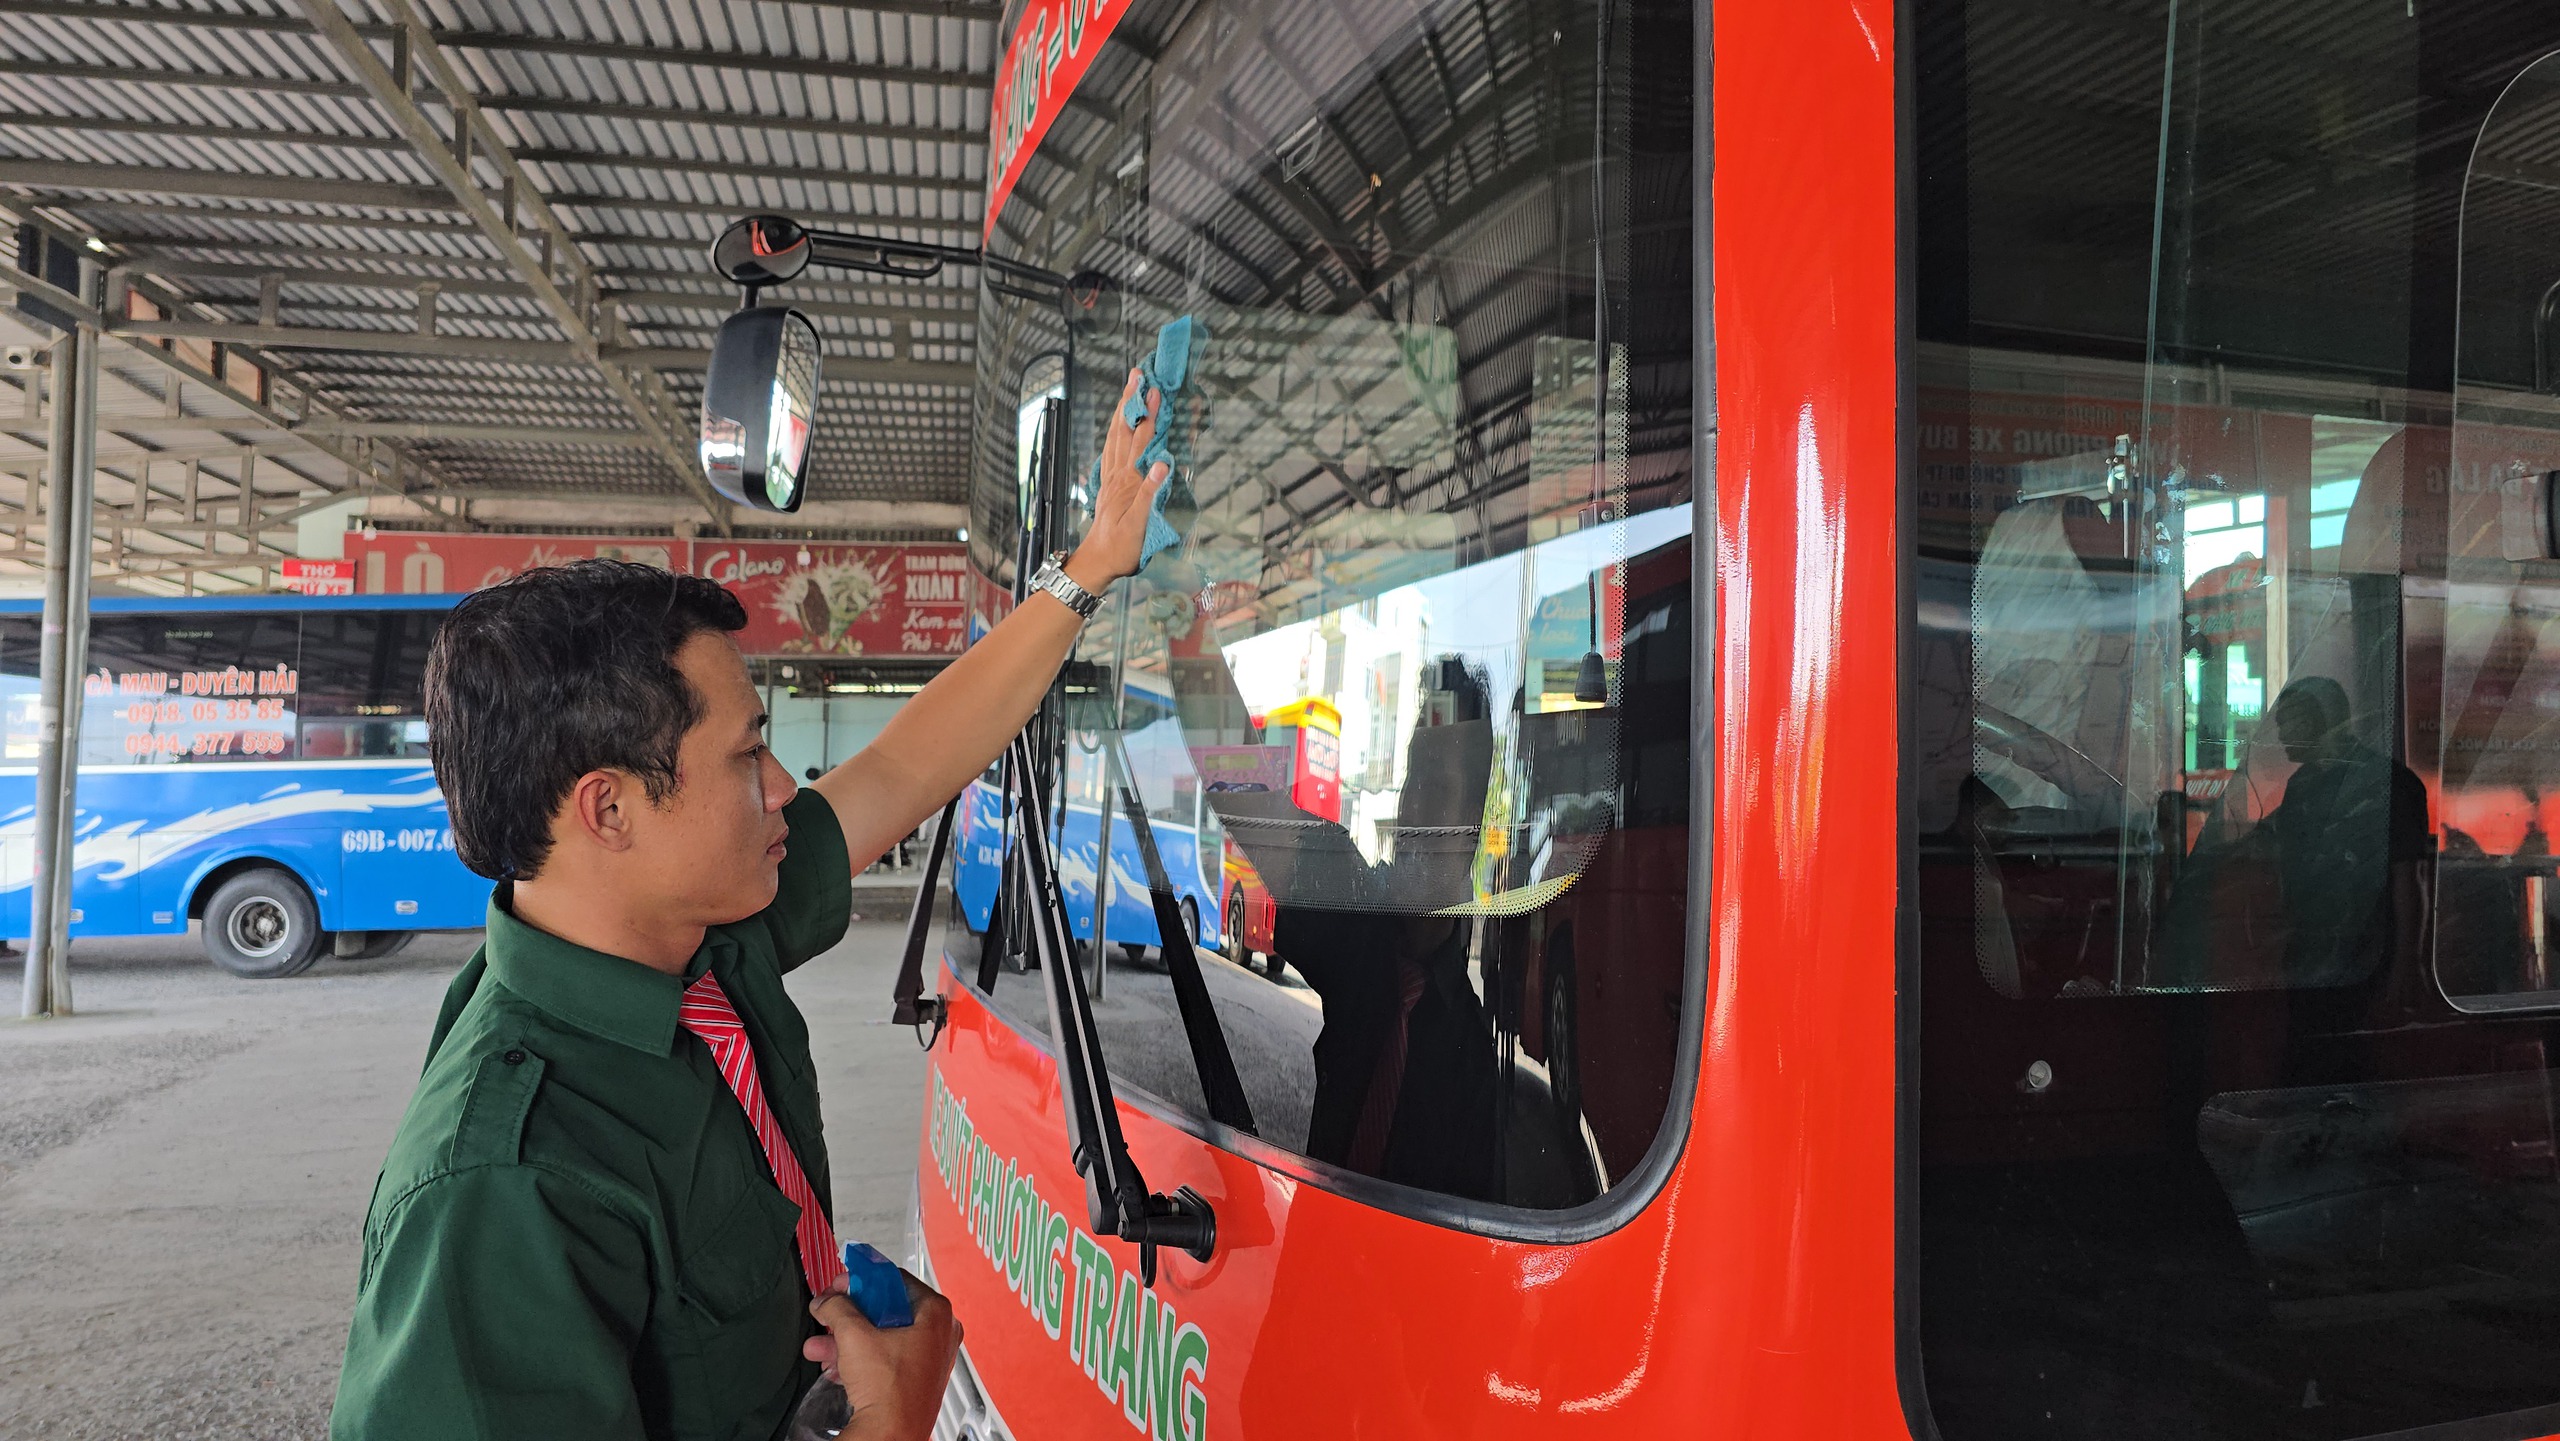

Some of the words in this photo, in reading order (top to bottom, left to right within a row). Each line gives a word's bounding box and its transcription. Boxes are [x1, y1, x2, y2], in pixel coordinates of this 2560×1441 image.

[703, 548, 786, 585] Celano
[905, 571, 955, 601] XUÂN
[902, 608, 945, 630] Kem
[85, 666, 113, 696] CÀ
[119, 672, 168, 696] MAU
[182, 664, 255, 696] DUYÊN
[258, 662, 299, 696] HẢI
[191, 700, 219, 722] 05
[224, 698, 252, 721] 35
[256, 697, 285, 721] 85
[192, 731, 236, 756] 377
[241, 731, 286, 755] 555
[938, 1086, 974, 1217] BUÝT
[967, 1132, 1069, 1341] PHƯƠNG
[1069, 1226, 1209, 1441] TRANG
